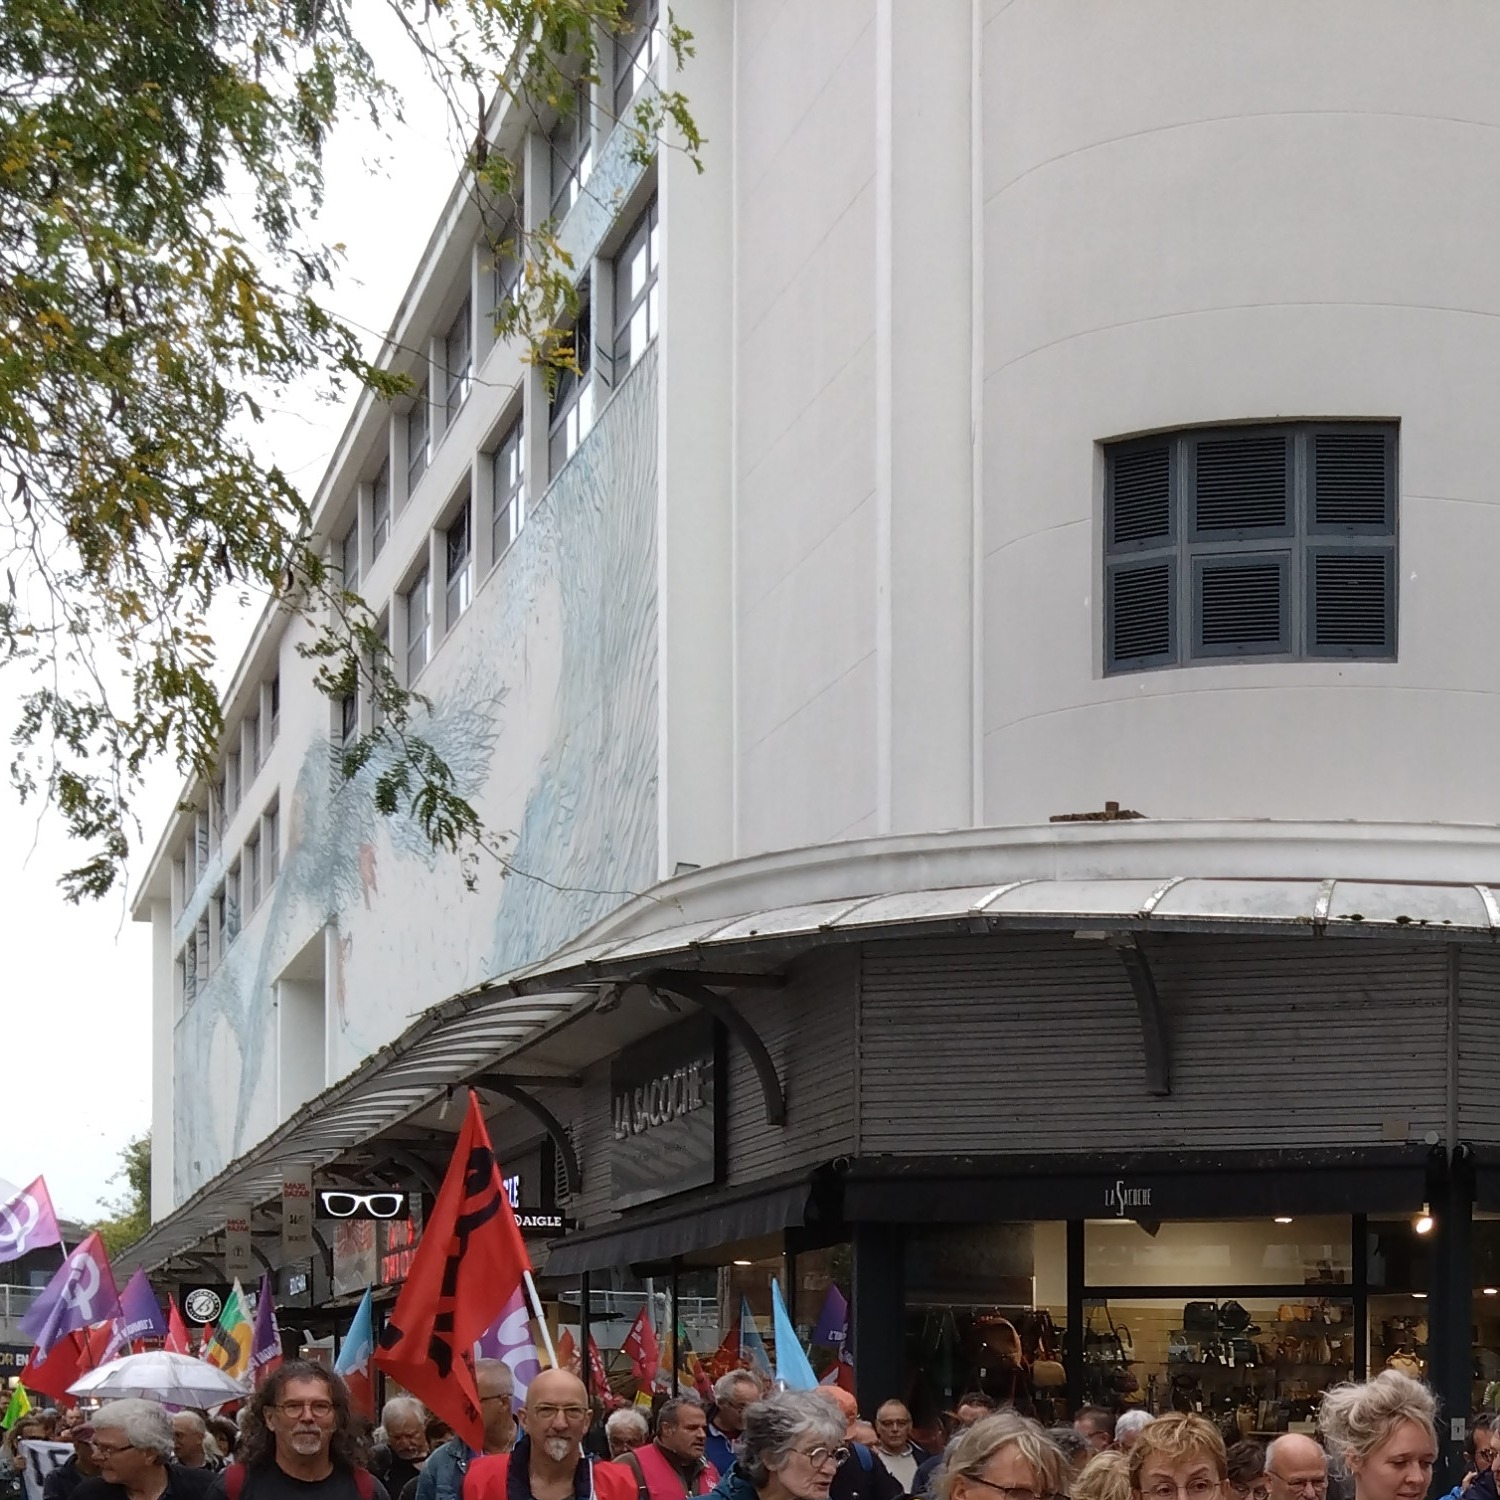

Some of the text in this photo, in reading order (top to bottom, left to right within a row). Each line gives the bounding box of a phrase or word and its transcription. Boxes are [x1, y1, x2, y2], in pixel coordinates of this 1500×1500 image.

[615, 1060, 704, 1140] LA SACOCHE
[522, 1216, 562, 1227] AIGLE
